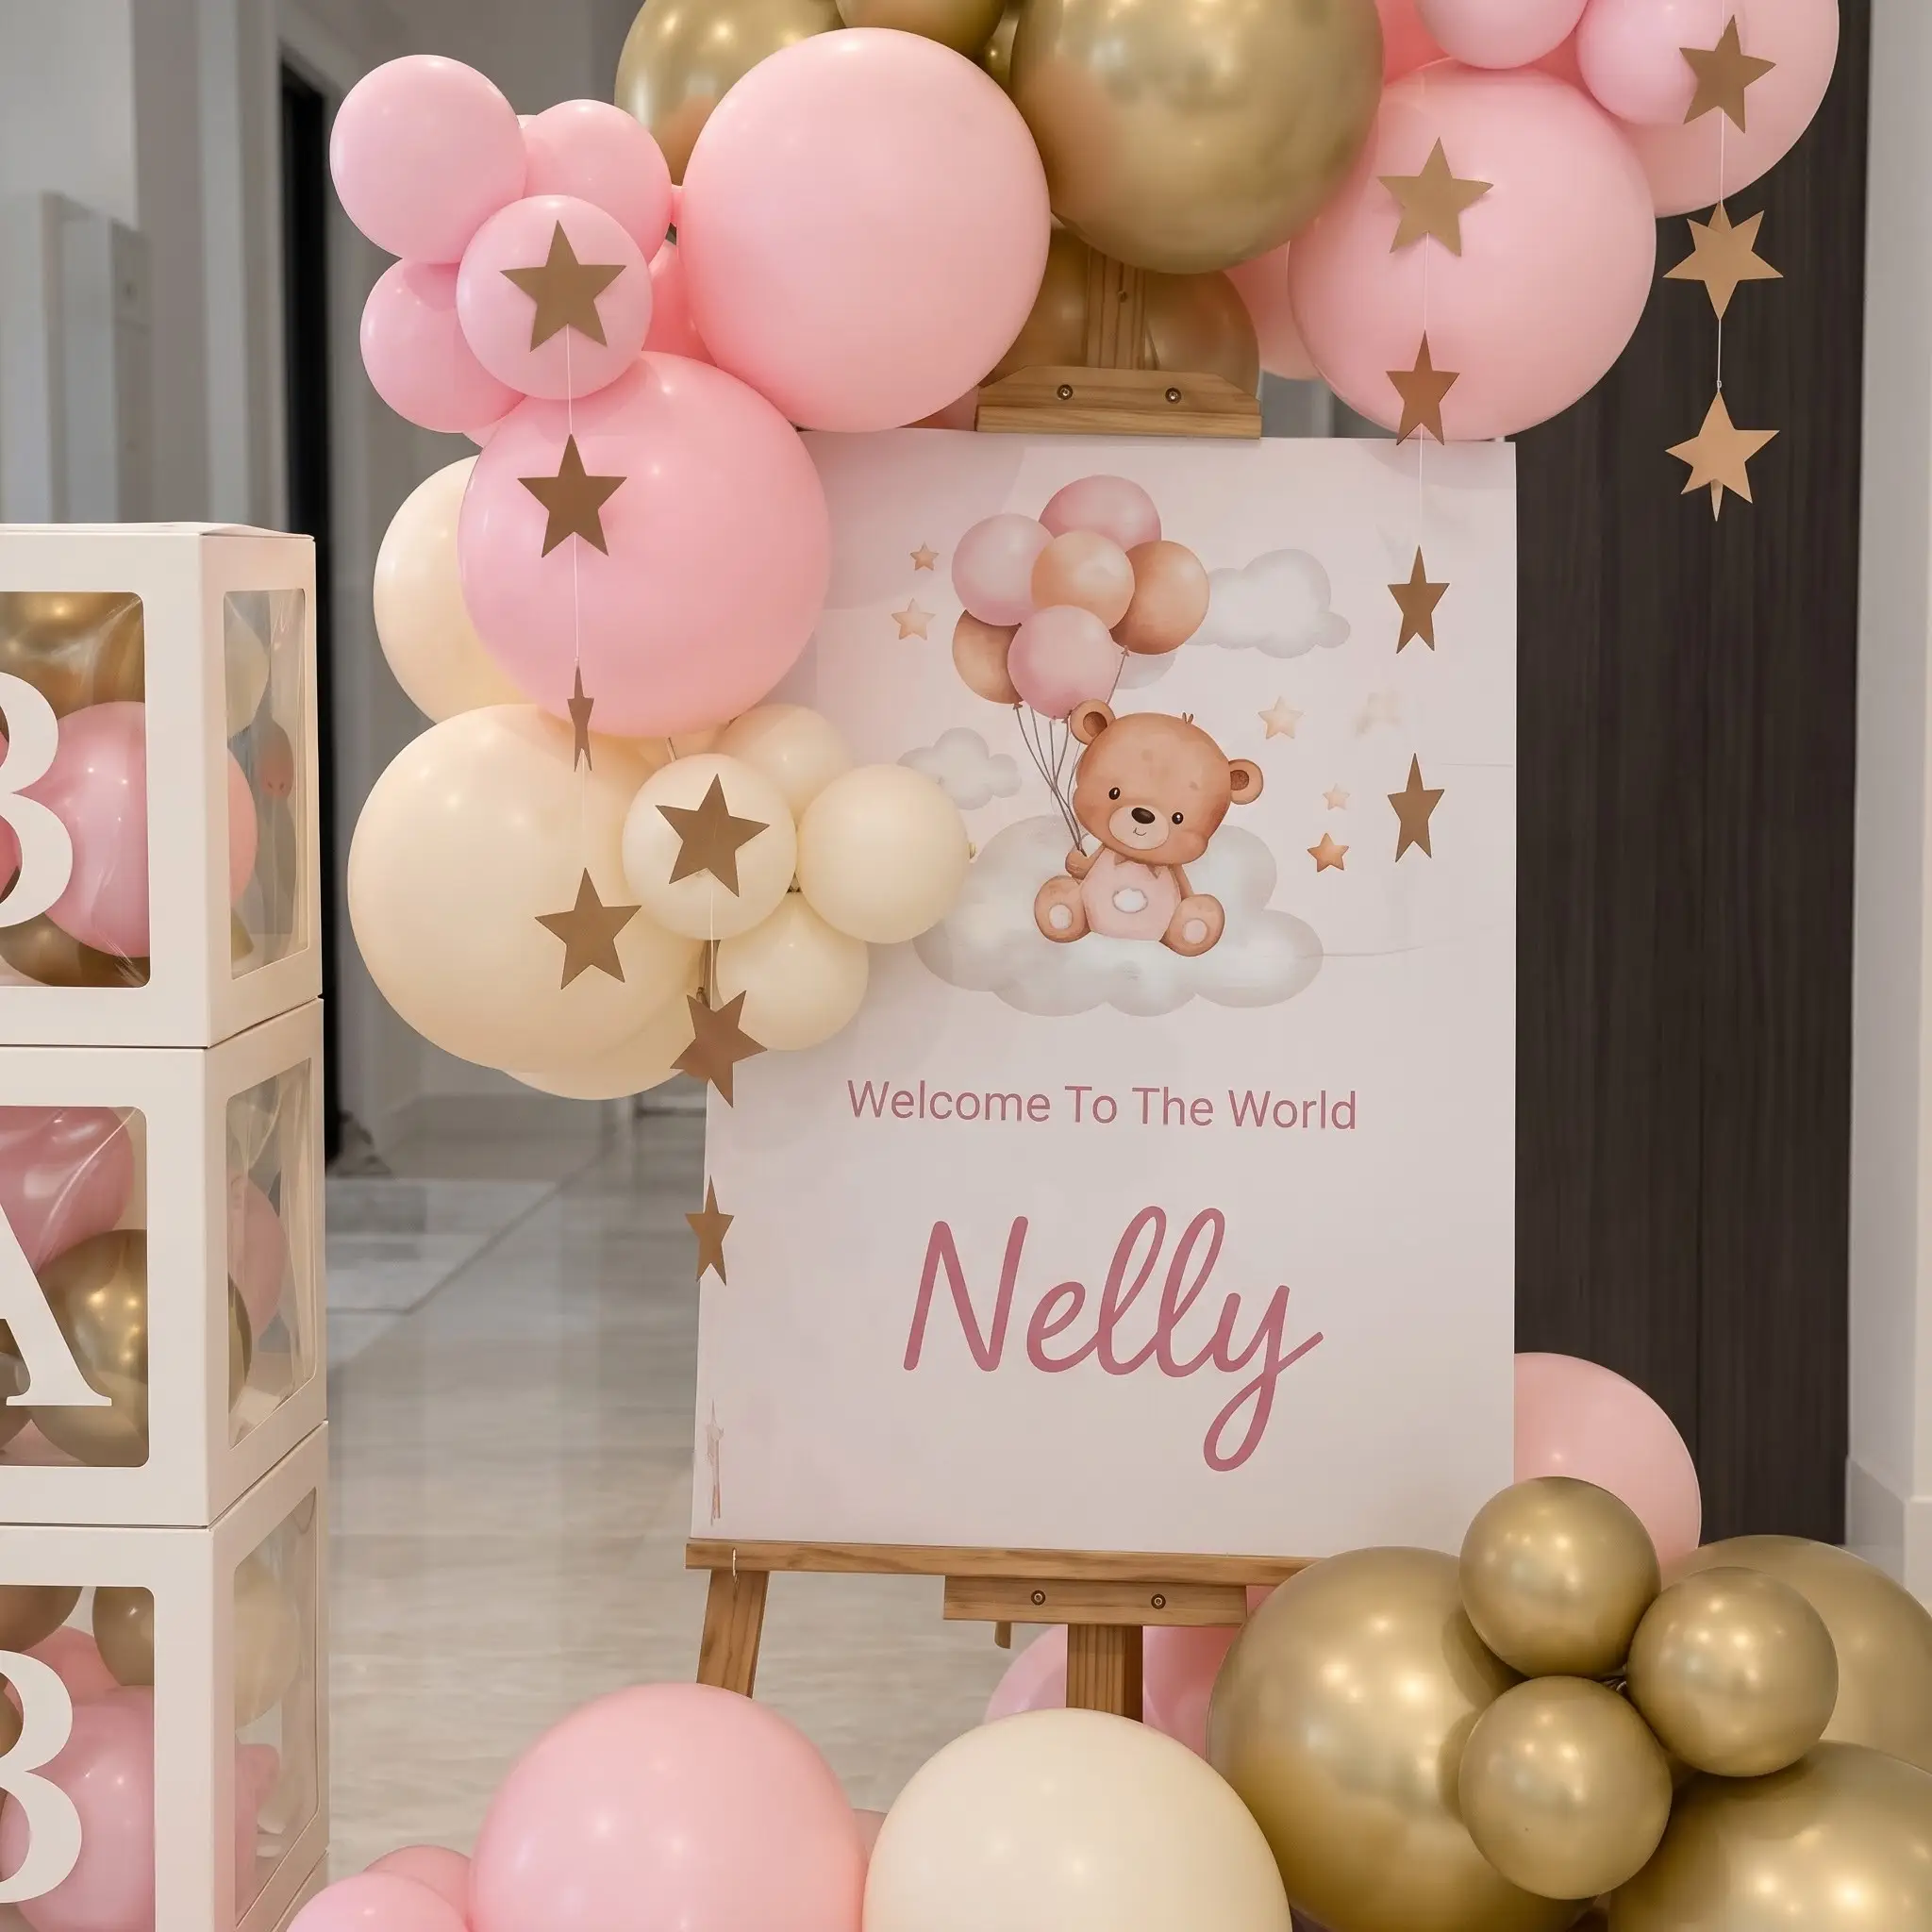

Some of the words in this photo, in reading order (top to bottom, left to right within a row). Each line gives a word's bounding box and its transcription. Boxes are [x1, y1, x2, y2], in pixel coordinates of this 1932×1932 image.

[846, 1079, 1051, 1123] Welcome
[1064, 1085, 1118, 1124] To
[1132, 1087, 1214, 1126] The
[1227, 1090, 1357, 1130] World
[903, 1205, 1324, 1473] Nelly
